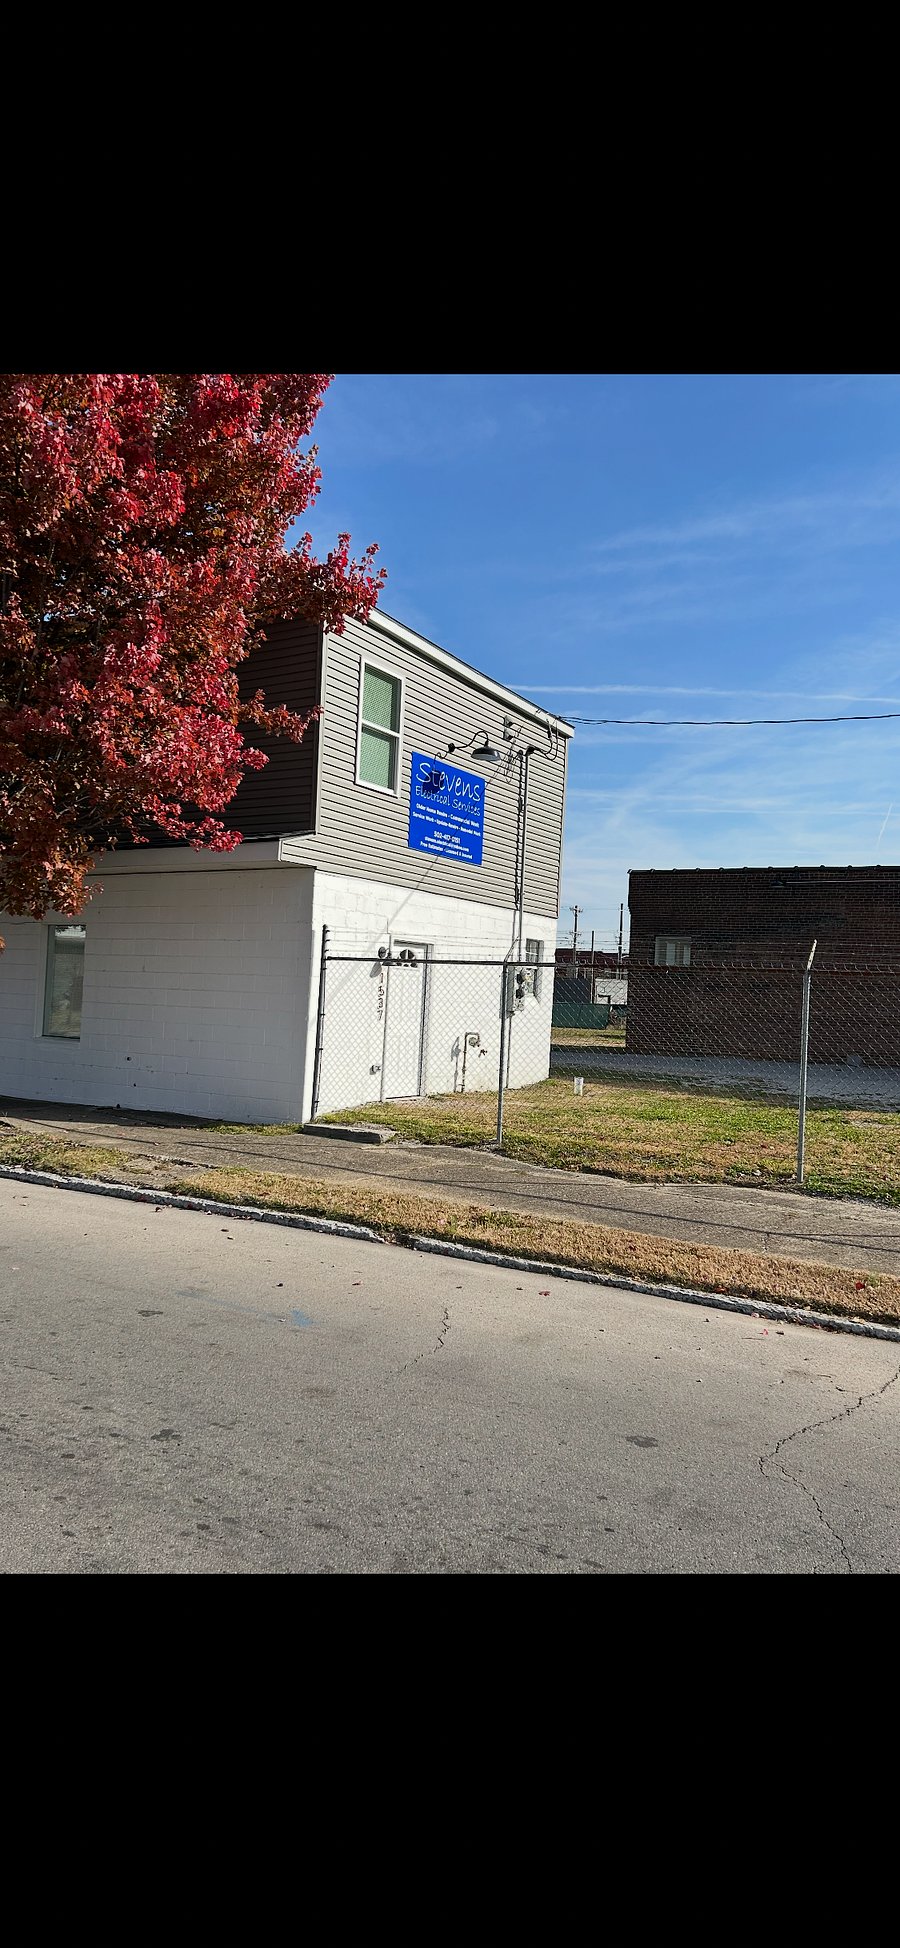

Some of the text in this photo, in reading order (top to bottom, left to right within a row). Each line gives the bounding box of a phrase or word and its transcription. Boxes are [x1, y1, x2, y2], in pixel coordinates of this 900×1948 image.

[416, 763, 481, 801] Stevens
[416, 786, 480, 816] Electrical Services
